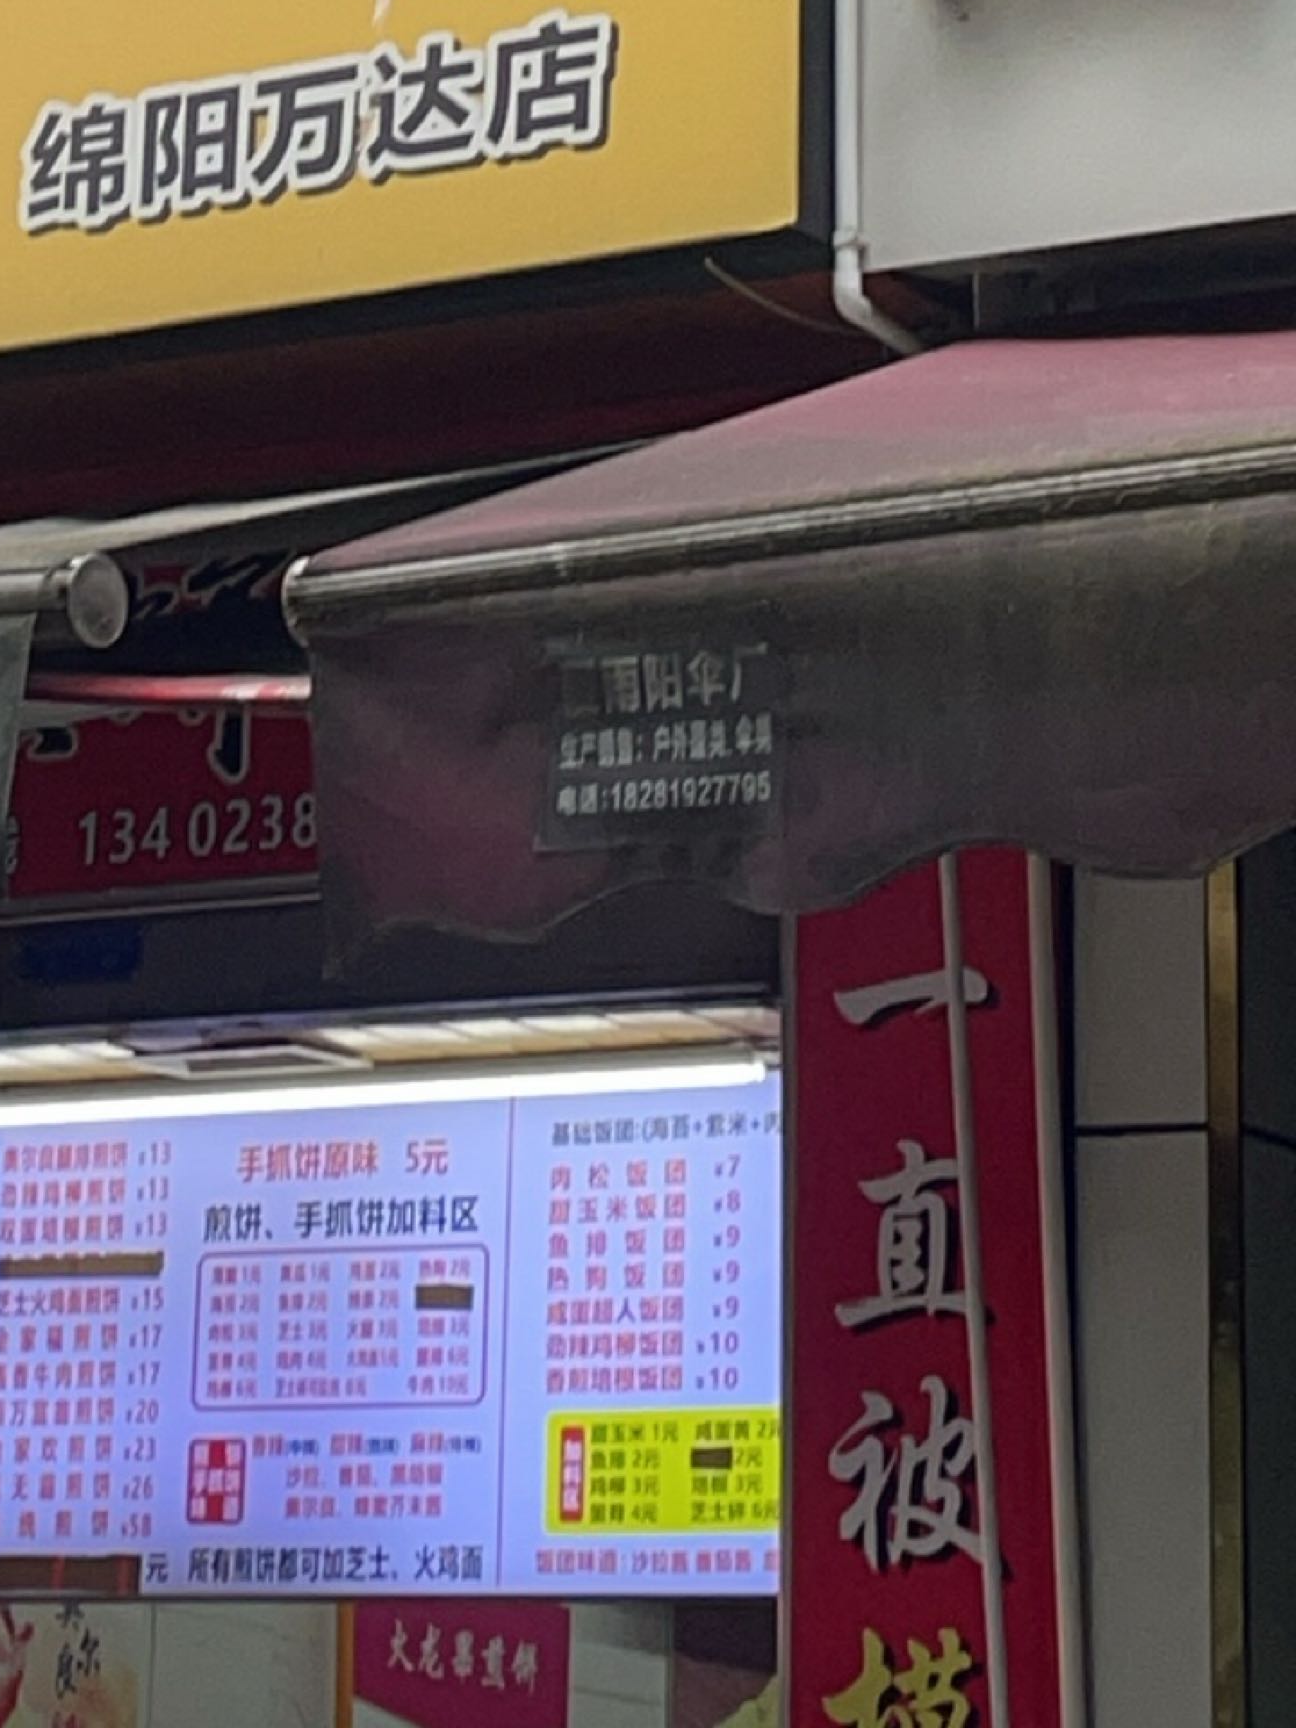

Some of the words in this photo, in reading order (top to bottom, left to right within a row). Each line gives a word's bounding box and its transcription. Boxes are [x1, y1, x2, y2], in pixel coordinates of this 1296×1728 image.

[19, 10, 618, 238] 绵阳万达店
[237, 1141, 378, 1183] 手抓饼原味
[405, 1139, 448, 1176] 5元
